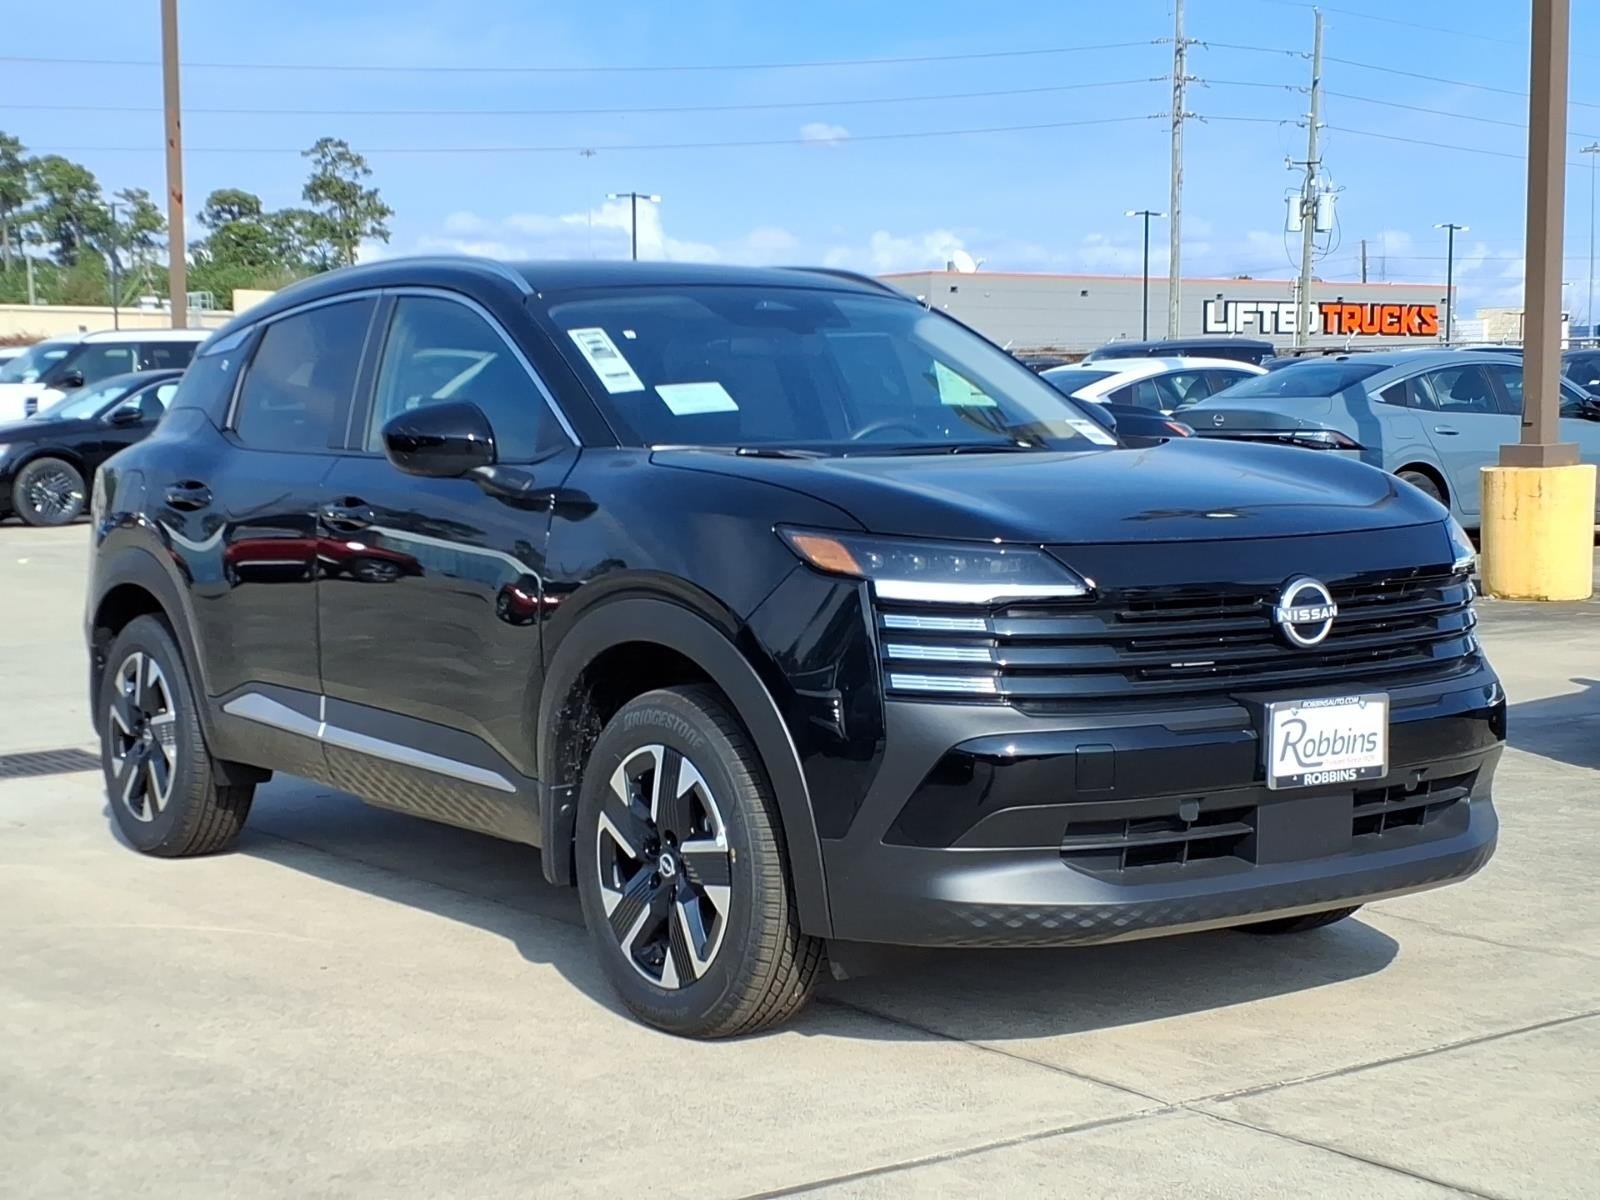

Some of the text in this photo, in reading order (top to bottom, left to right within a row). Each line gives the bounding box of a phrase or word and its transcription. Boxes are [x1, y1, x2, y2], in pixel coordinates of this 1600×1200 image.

[1320, 302, 1440, 336] TRUCKS
[1278, 604, 1338, 622] NISSAN
[623, 709, 704, 750] BRIDGESTONE
[1280, 718, 1378, 768] Robbins
[1304, 768, 1357, 786] ROBBINS
